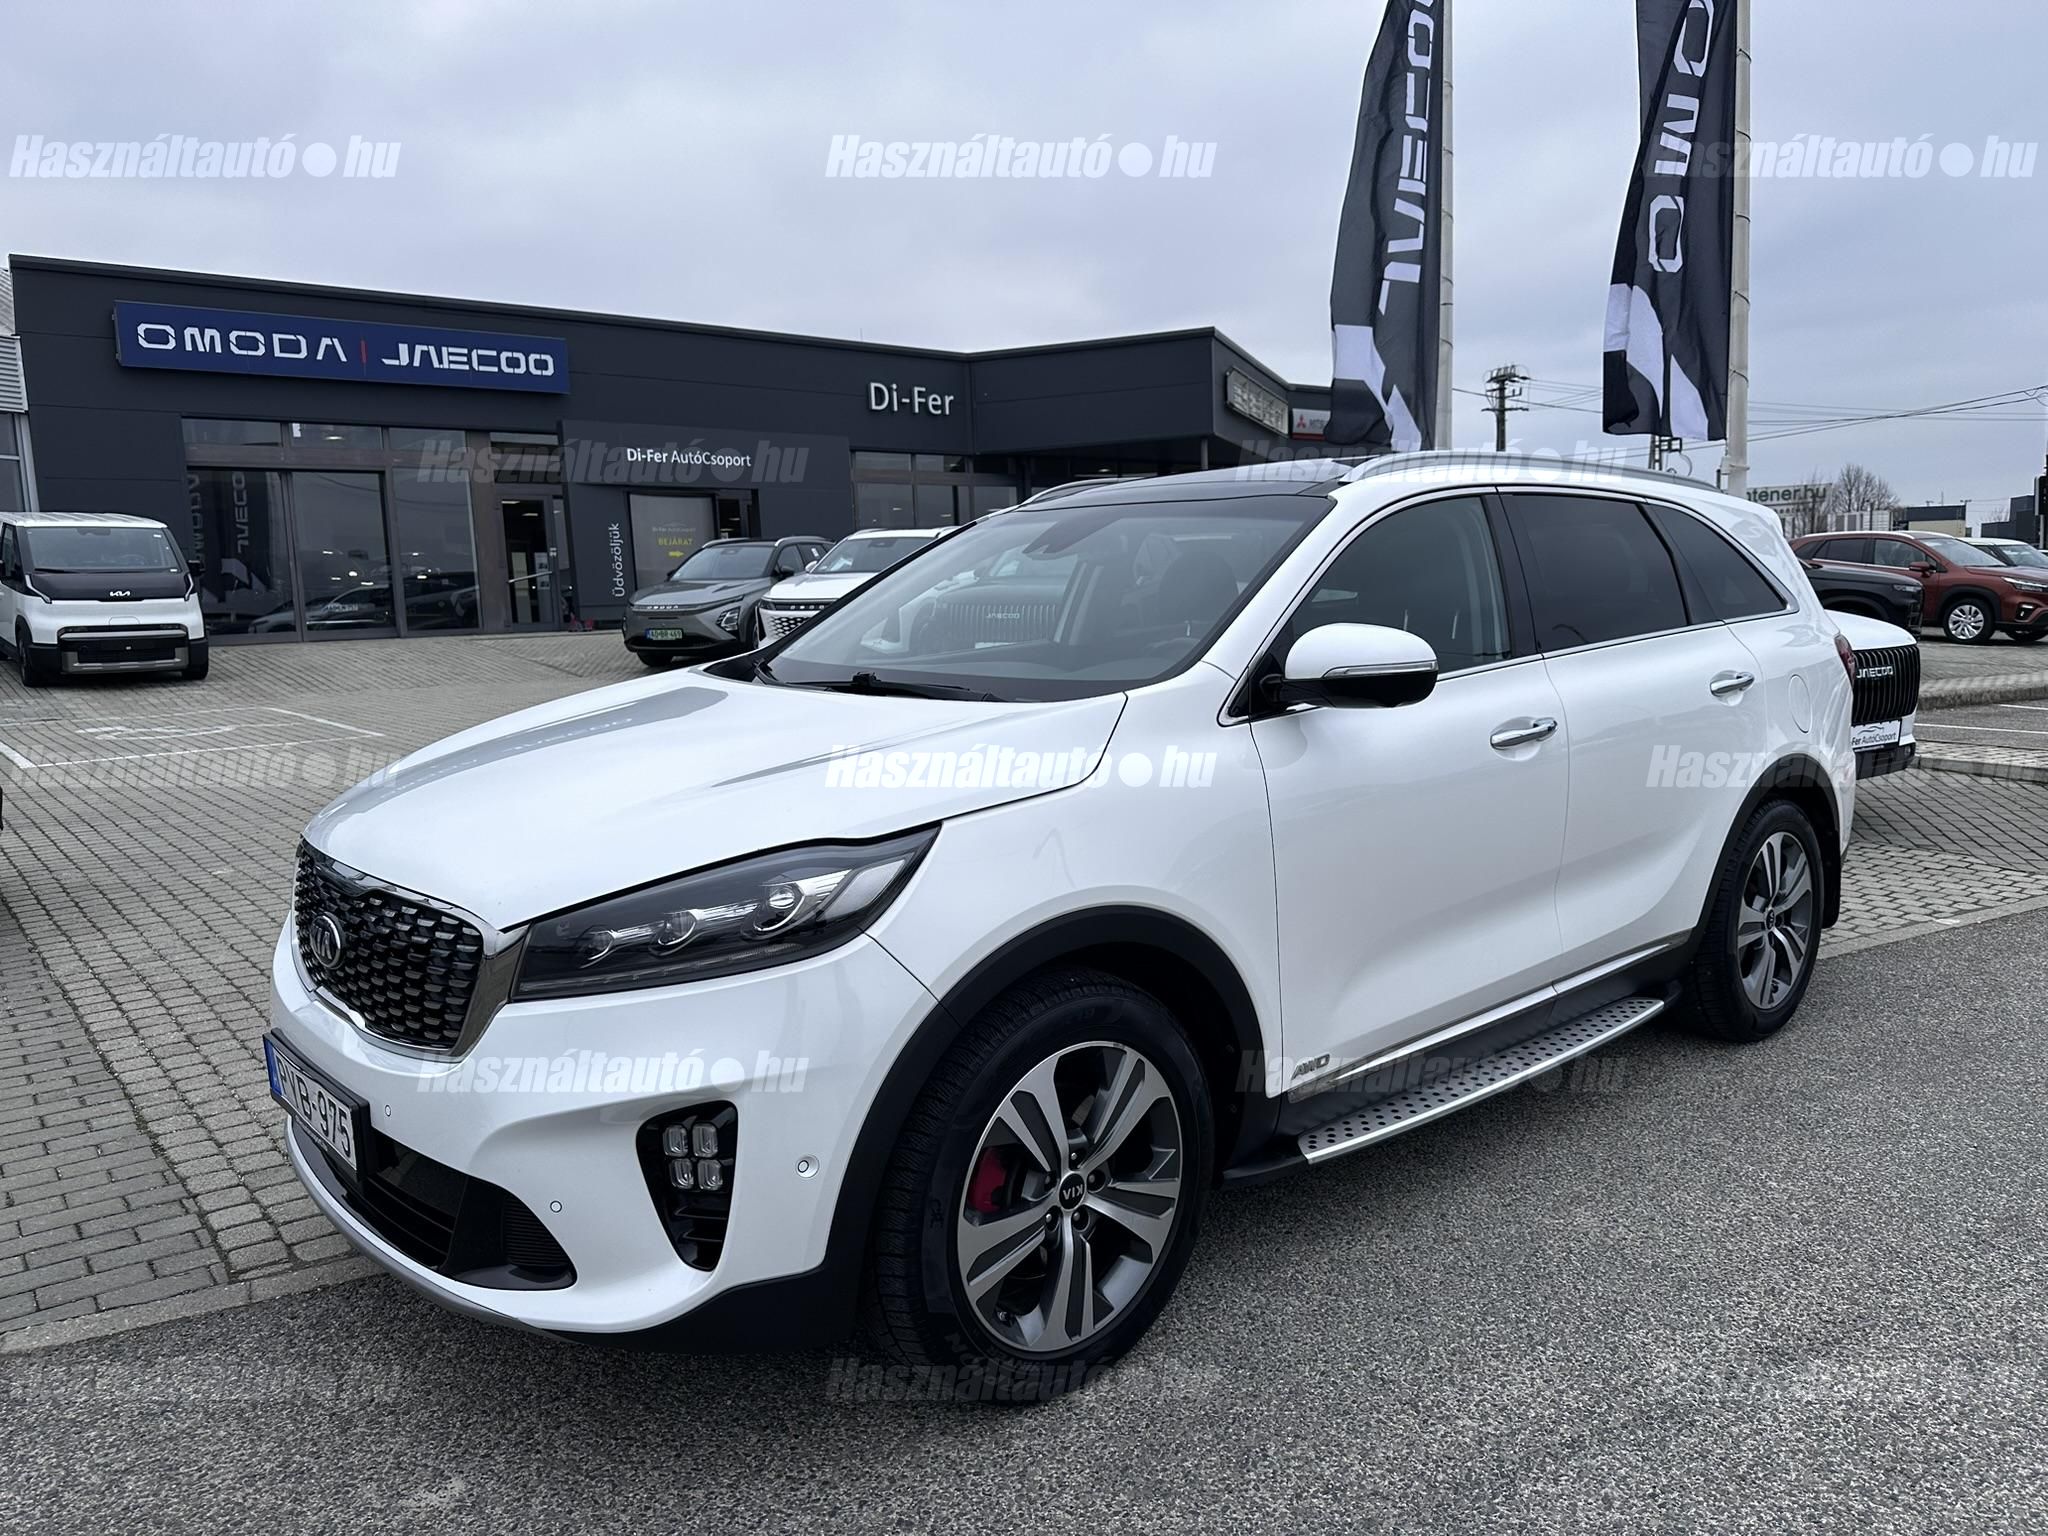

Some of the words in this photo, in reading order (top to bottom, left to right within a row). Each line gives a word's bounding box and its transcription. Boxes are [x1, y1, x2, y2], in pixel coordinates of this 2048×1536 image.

[137, 323, 348, 362] OMODA
[381, 342, 555, 376] JAECOO
[869, 381, 955, 416] Di-Fer
[626, 448, 668, 462] Di-Fer
[671, 450, 752, 468] AutóCsoport
[608, 522, 625, 598] Üdvözöljük
[1856, 666, 1894, 679] JAECOO
[1291, 1053, 1331, 1080] AWD
